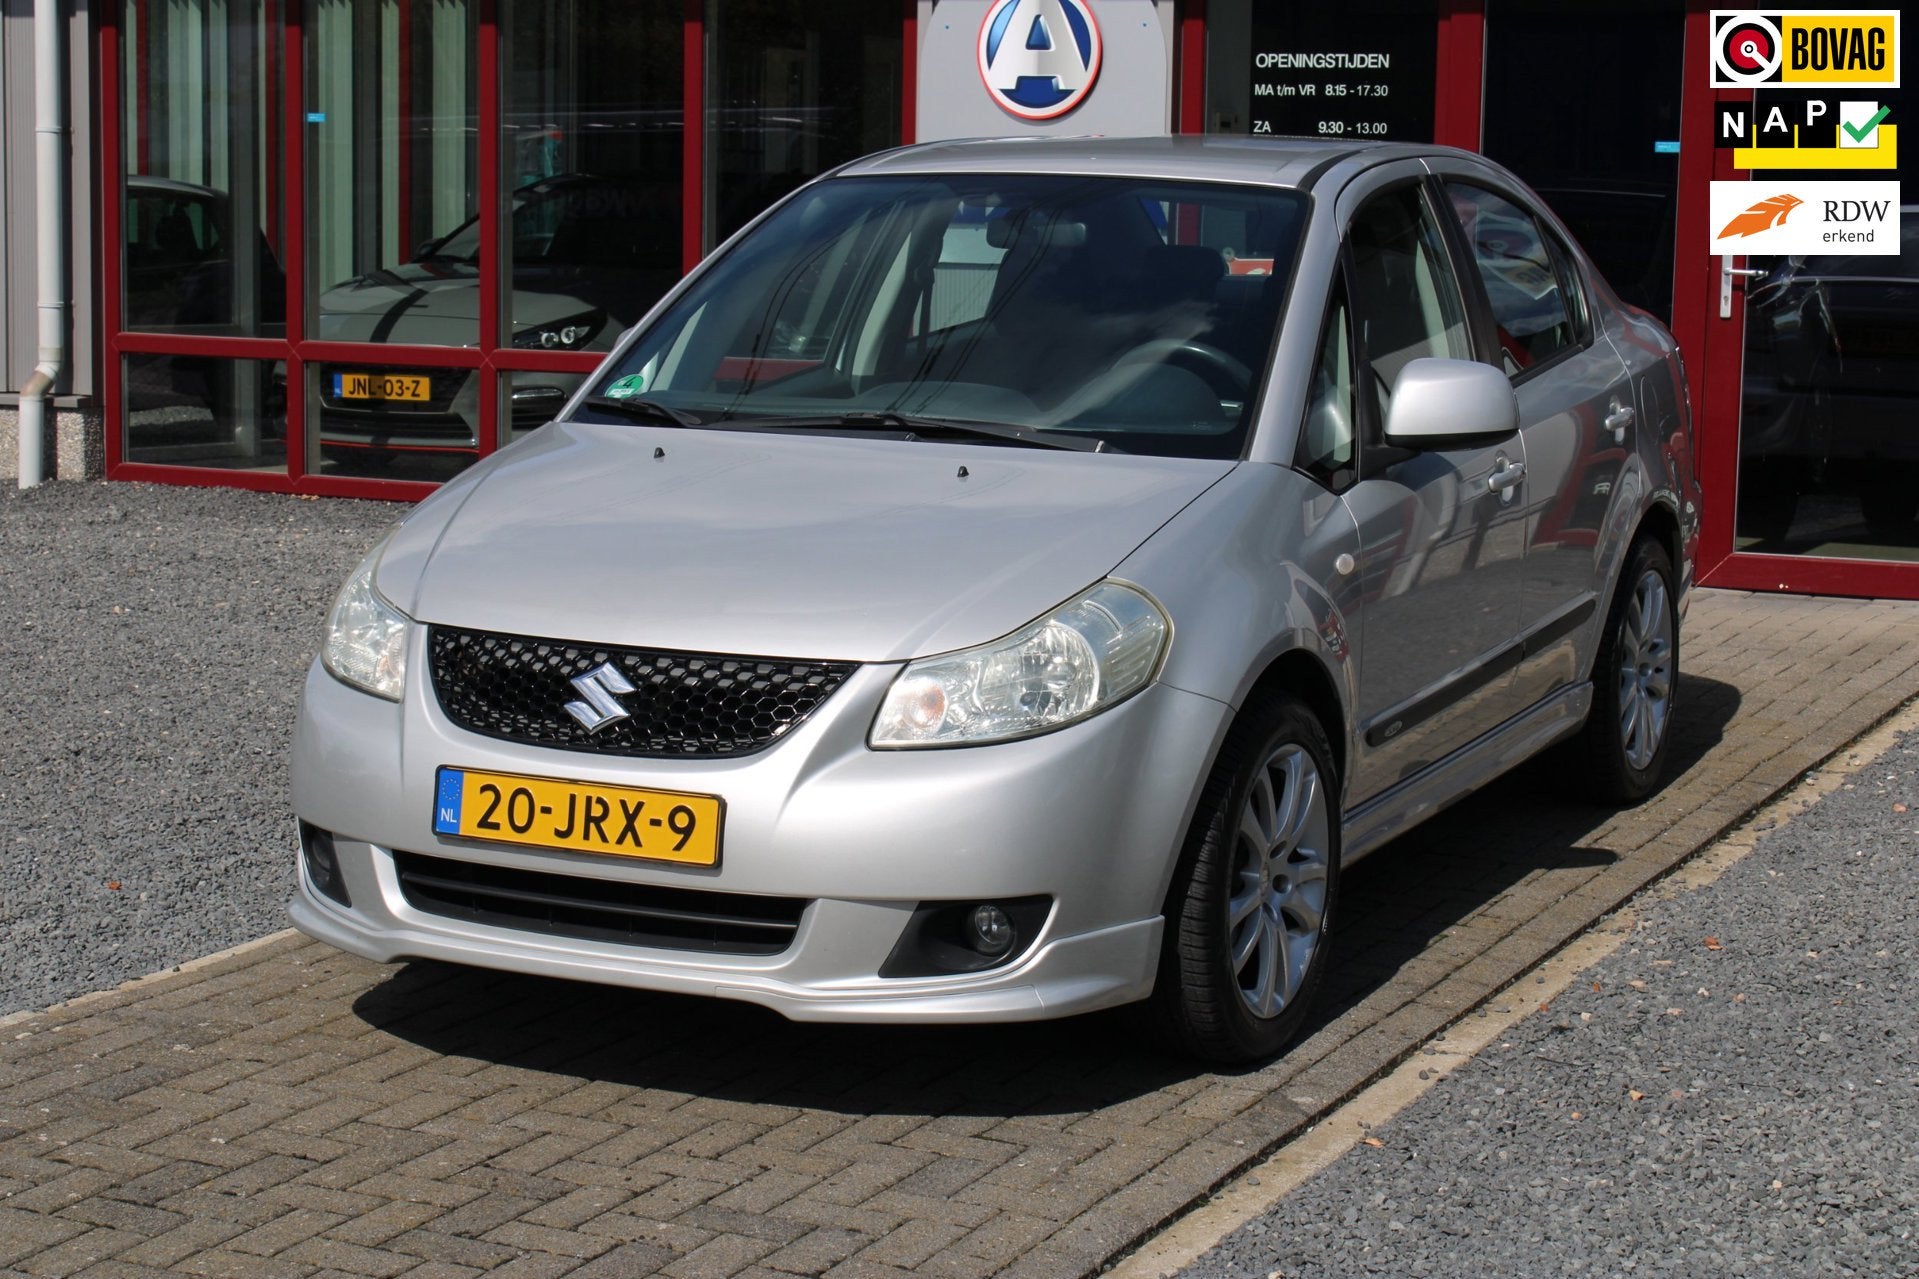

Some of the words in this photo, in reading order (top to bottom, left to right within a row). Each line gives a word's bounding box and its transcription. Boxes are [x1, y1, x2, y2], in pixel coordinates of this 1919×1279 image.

[1255, 53, 1389, 68] OPENINGSTIJDEN
[1254, 84, 1274, 96] MA
[1276, 84, 1295, 97] t/m
[1298, 84, 1316, 96] VR
[1325, 84, 1347, 96] 8.15
[1356, 85, 1388, 97] 17.30
[1253, 121, 1271, 133] ZA
[1318, 121, 1344, 134] 9.30
[1355, 122, 1388, 134] 13.00
[348, 377, 421, 397] JNL-03-Z
[622, 376, 637, 389] 4
[440, 807, 458, 823] NL
[476, 783, 697, 852] 20-JRX-9
